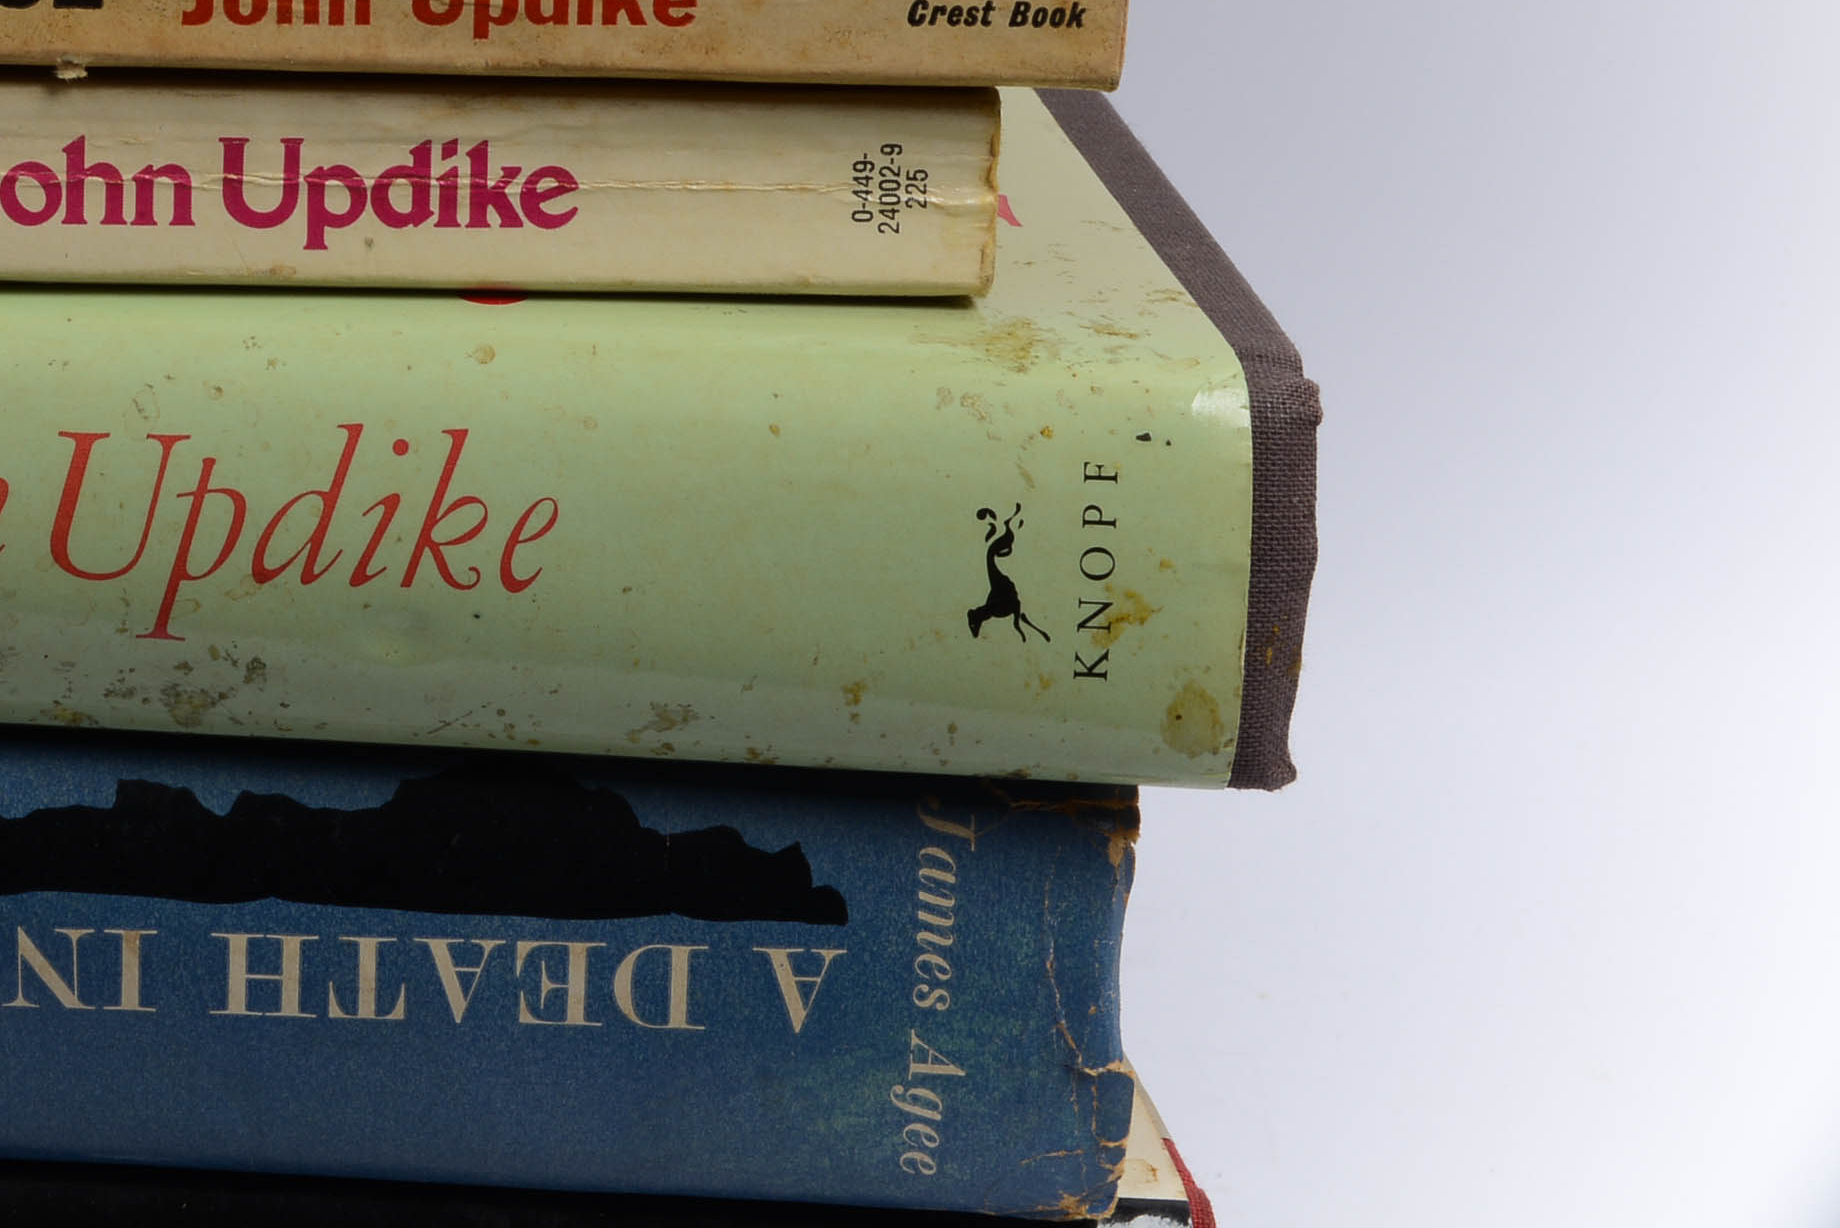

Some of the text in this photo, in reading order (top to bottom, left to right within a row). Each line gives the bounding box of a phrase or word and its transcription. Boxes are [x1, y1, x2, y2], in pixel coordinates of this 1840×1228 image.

[1009, 1, 1086, 28] Book
[219, 137, 579, 250] Updike
[852, 153, 875, 222] 0-449-
[878, 144, 902, 233] 24002-9
[905, 169, 928, 208] 225
[50, 424, 558, 641] Updike
[1072, 461, 1118, 681] KNOPF
[2, 926, 157, 1012] IN
[210, 933, 709, 1029] DEATH
[752, 948, 847, 1033] A
[890, 795, 975, 1175] James Agee
